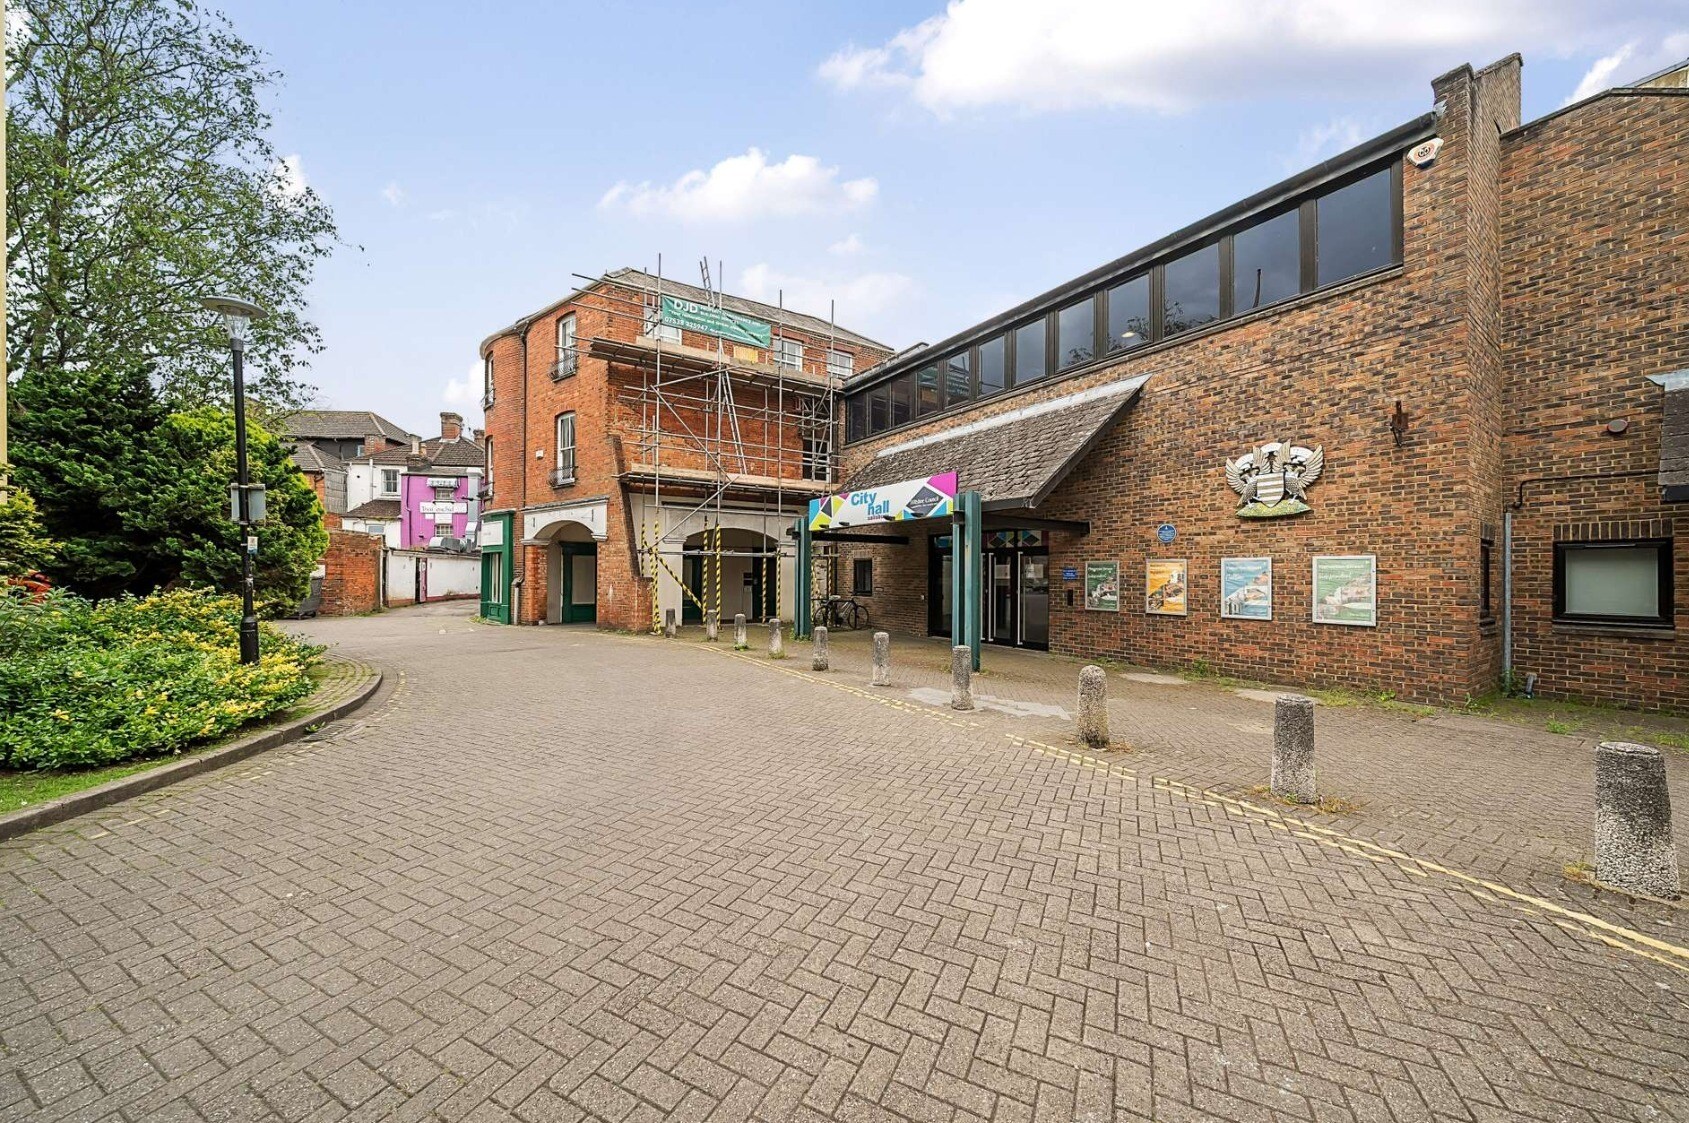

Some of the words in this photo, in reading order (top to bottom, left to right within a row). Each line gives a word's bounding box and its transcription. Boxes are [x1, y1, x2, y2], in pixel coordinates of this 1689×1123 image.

[673, 299, 698, 314] DJD
[851, 491, 877, 507] City
[867, 500, 890, 516] hall
